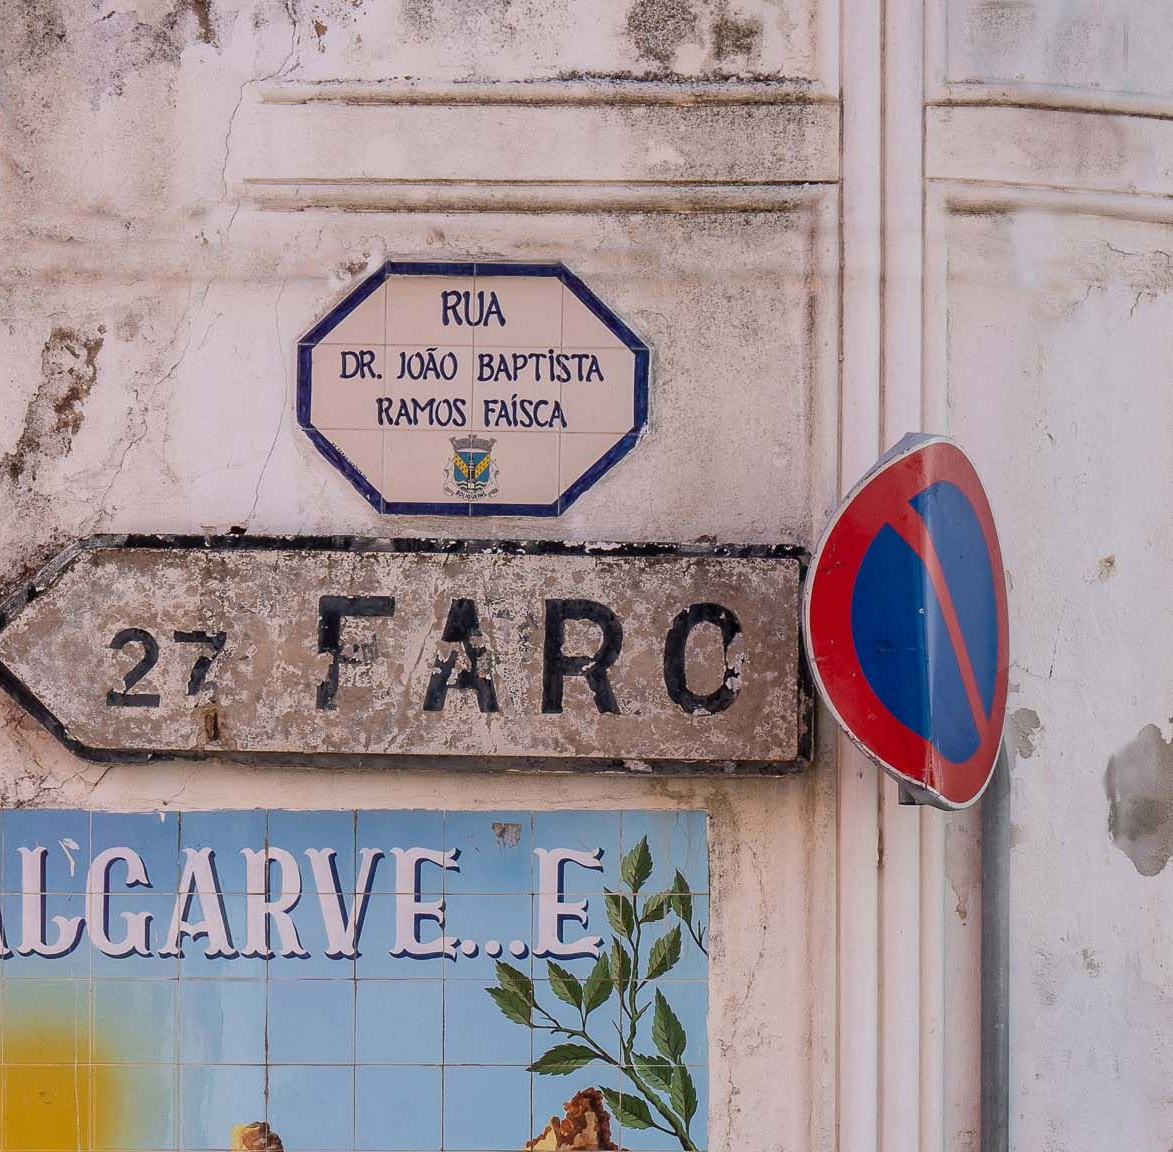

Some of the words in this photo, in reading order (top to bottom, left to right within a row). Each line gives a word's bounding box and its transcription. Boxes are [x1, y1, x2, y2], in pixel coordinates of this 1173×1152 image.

[441, 290, 506, 327] RUA
[339, 350, 383, 380] DR.
[396, 347, 459, 381] JOÃO
[477, 349, 604, 382] BAPTISTA
[376, 397, 467, 428] RAMOS
[483, 393, 568, 429] FAÍSCA
[106, 627, 228, 707] 27
[316, 596, 741, 714] FARO
